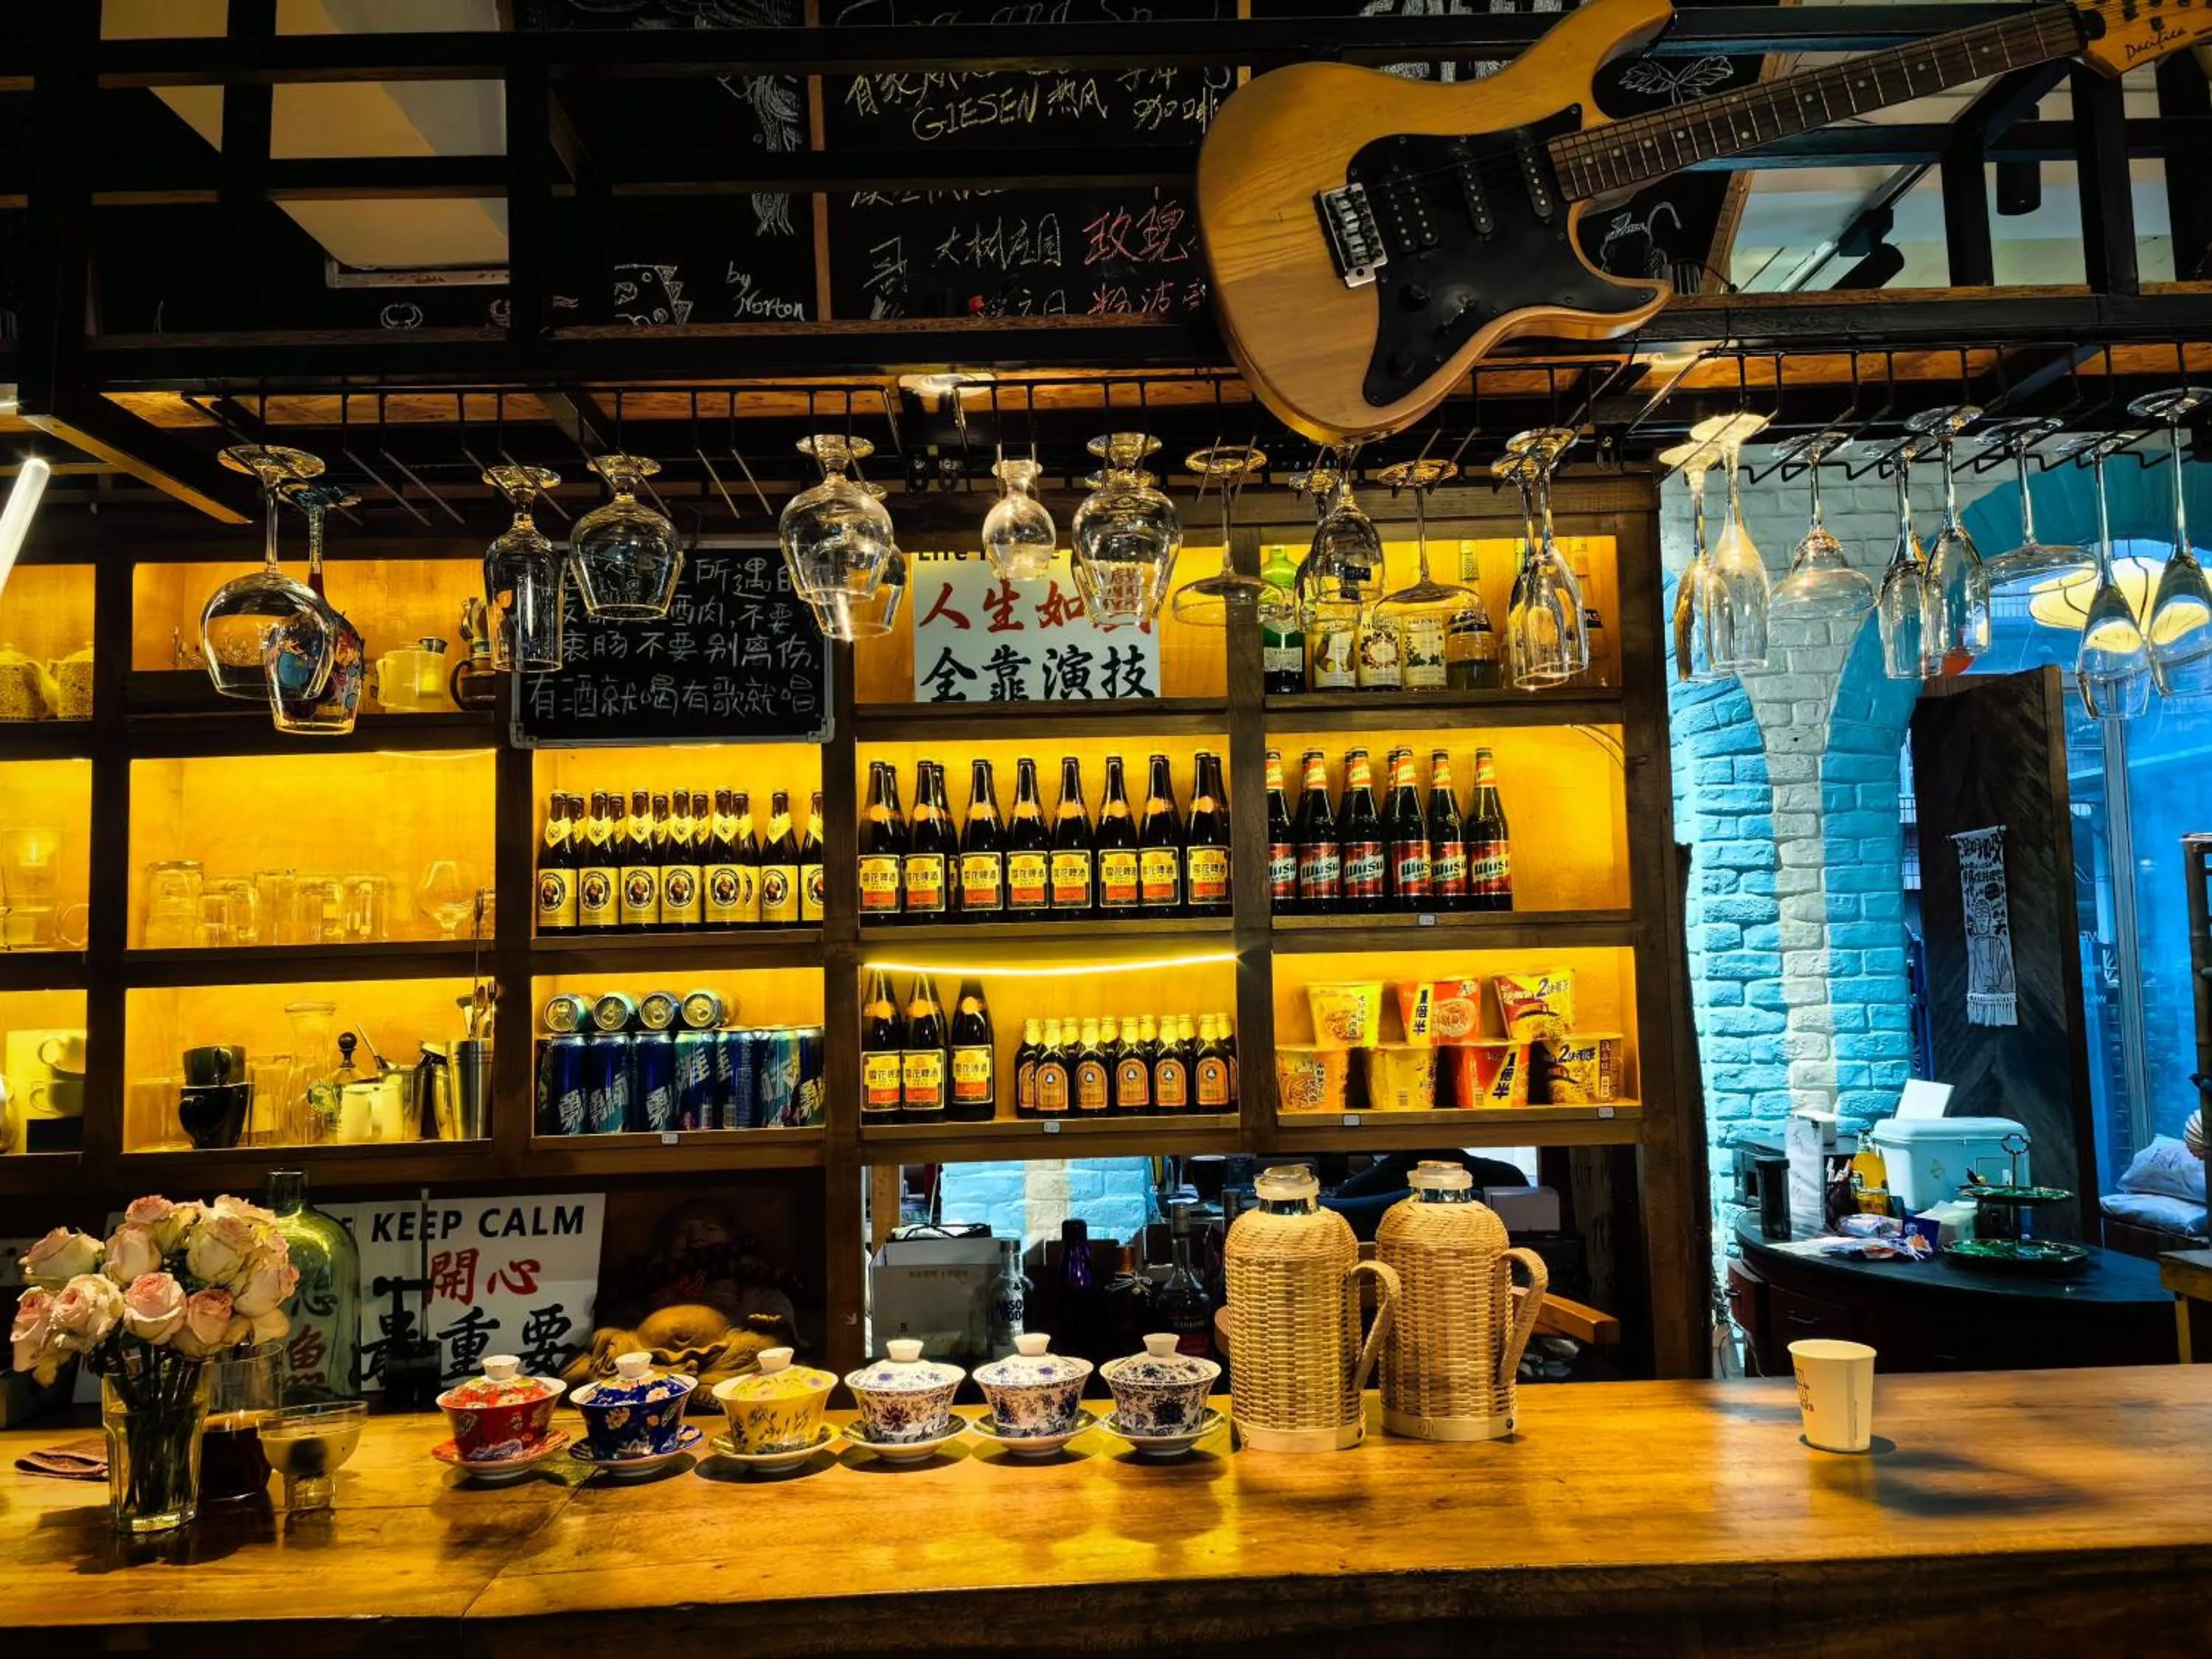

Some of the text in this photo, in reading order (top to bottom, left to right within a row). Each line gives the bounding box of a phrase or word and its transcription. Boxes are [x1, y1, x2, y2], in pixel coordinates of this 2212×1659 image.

[912, 80, 1040, 142] GIESEN
[726, 261, 752, 299] by
[734, 291, 805, 322] Norton
[919, 579, 1152, 635] 人生如
[920, 644, 1155, 702] 全靠演技
[371, 1205, 585, 1242] KEEP CALM
[422, 1247, 541, 1305] 開心
